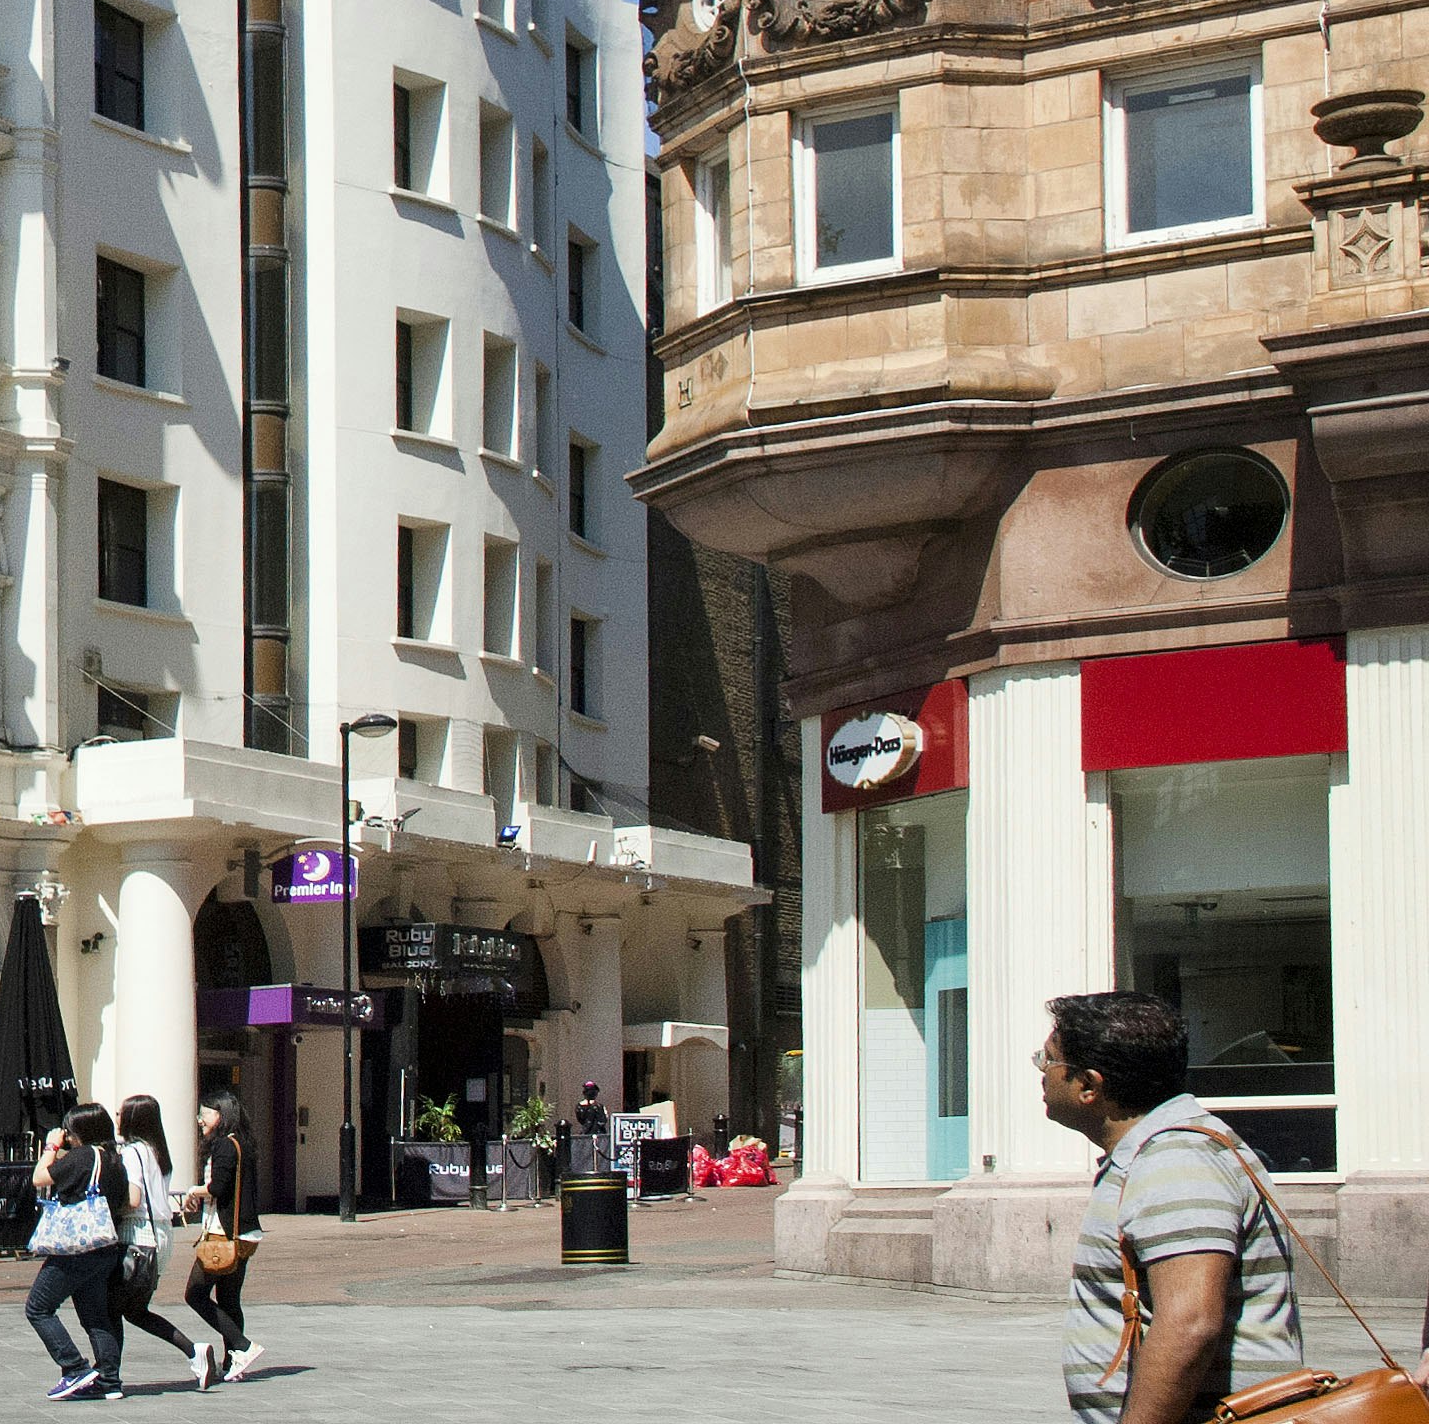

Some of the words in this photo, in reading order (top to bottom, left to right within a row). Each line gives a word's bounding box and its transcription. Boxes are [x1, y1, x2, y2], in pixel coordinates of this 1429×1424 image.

[274, 882, 330, 897] Premier
[330, 881, 352, 896] In
[386, 928, 433, 943] Ruby
[389, 944, 431, 958] Blue
[382, 959, 437, 969] BALCONY
[621, 1120, 654, 1132] Ruby
[428, 1163, 470, 1176] Ruby
